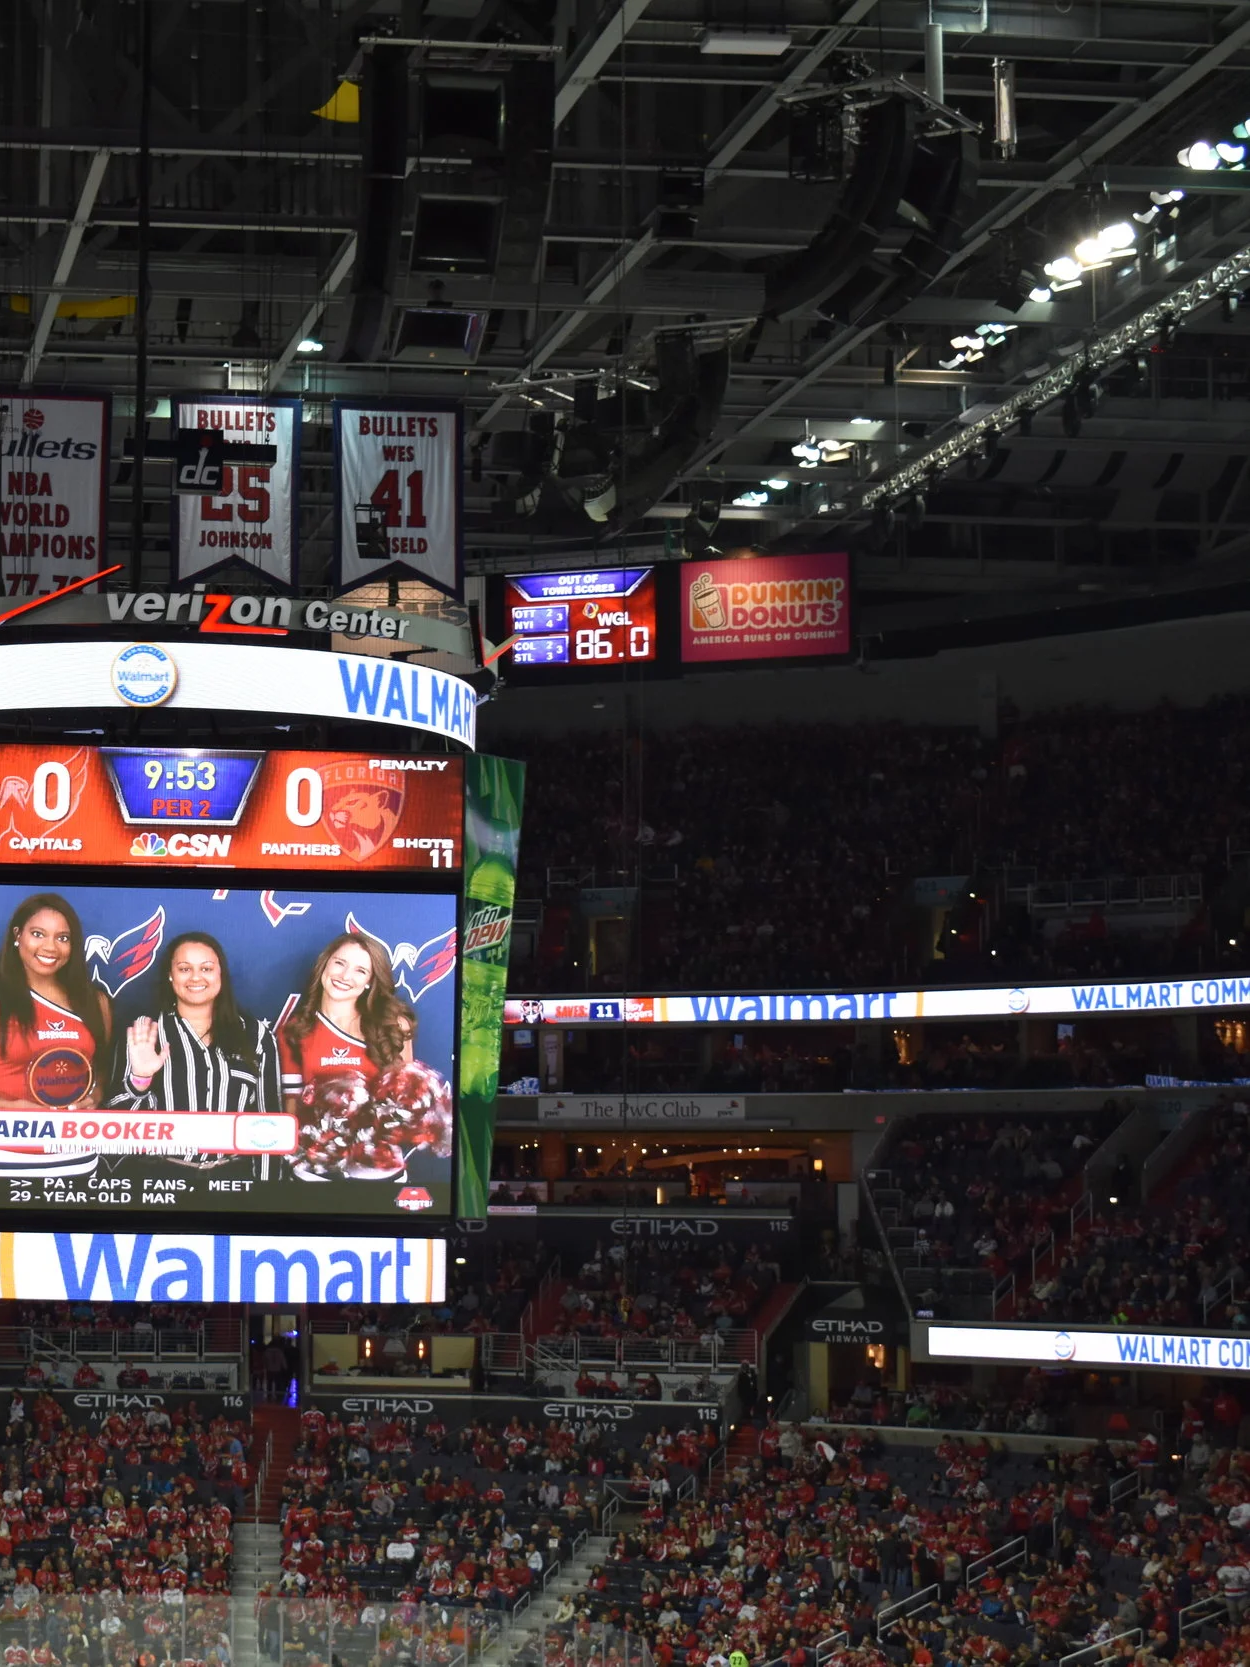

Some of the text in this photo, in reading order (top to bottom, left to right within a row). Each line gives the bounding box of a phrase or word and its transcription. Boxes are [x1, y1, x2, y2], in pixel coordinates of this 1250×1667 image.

[197, 409, 276, 431] BULLETS
[359, 416, 438, 437] BULLETS
[382, 445, 414, 462] WES
[8, 472, 53, 497] NBA
[370, 469, 427, 528] 41
[199, 530, 272, 549] JOHNSON
[558, 574, 599, 585] OUT OF
[542, 583, 616, 596] TOWN SCORES
[731, 579, 842, 605] DUNKIN'
[107, 583, 411, 640] verizon Center
[514, 609, 536, 619] OTT
[598, 612, 632, 626] WGL
[731, 602, 838, 628] DONUTS
[514, 621, 534, 630] NYI
[514, 641, 536, 651] COL
[576, 627, 649, 660] 86.0
[693, 632, 791, 645] AMERICA RUNS ON
[514, 653, 535, 663] STL
[117, 670, 170, 684] Walmart
[369, 760, 448, 772] PENALTY
[324, 766, 398, 786] FLORIDA
[33, 760, 323, 827] 0 9:53 0
[152, 798, 211, 817] PER 2
[9, 837, 82, 851] CAPITALS
[167, 834, 232, 858] CSN
[261, 842, 341, 856] PANTHERS
[392, 838, 455, 848] SHOTS
[429, 849, 454, 868] 11
[1071, 983, 1184, 1010] WALMART
[596, 1004, 614, 1018] 11
[690, 991, 898, 1022] Walmart
[581, 1100, 701, 1118] The PwC Club
[61, 1121, 174, 1140] BOOKER
[43, 1178, 74, 1188] PA:
[97, 1178, 132, 1189] CAPS
[143, 1179, 195, 1192] FANS,
[208, 1180, 254, 1191] MEET
[9, 1191, 176, 1204] 29-YEAR-OLD MAR
[610, 1219, 789, 1235] ETIHAD 115
[52, 1232, 411, 1303] Walmart
[811, 1319, 884, 1333] ETIHAD
[824, 1335, 871, 1344] AIRWAYS
[1115, 1334, 1211, 1366] WALMART
[73, 1394, 244, 1408] ETIHAD 116
[342, 1398, 434, 1414] ETIHAD
[543, 1403, 719, 1421] ETIHAD 115
